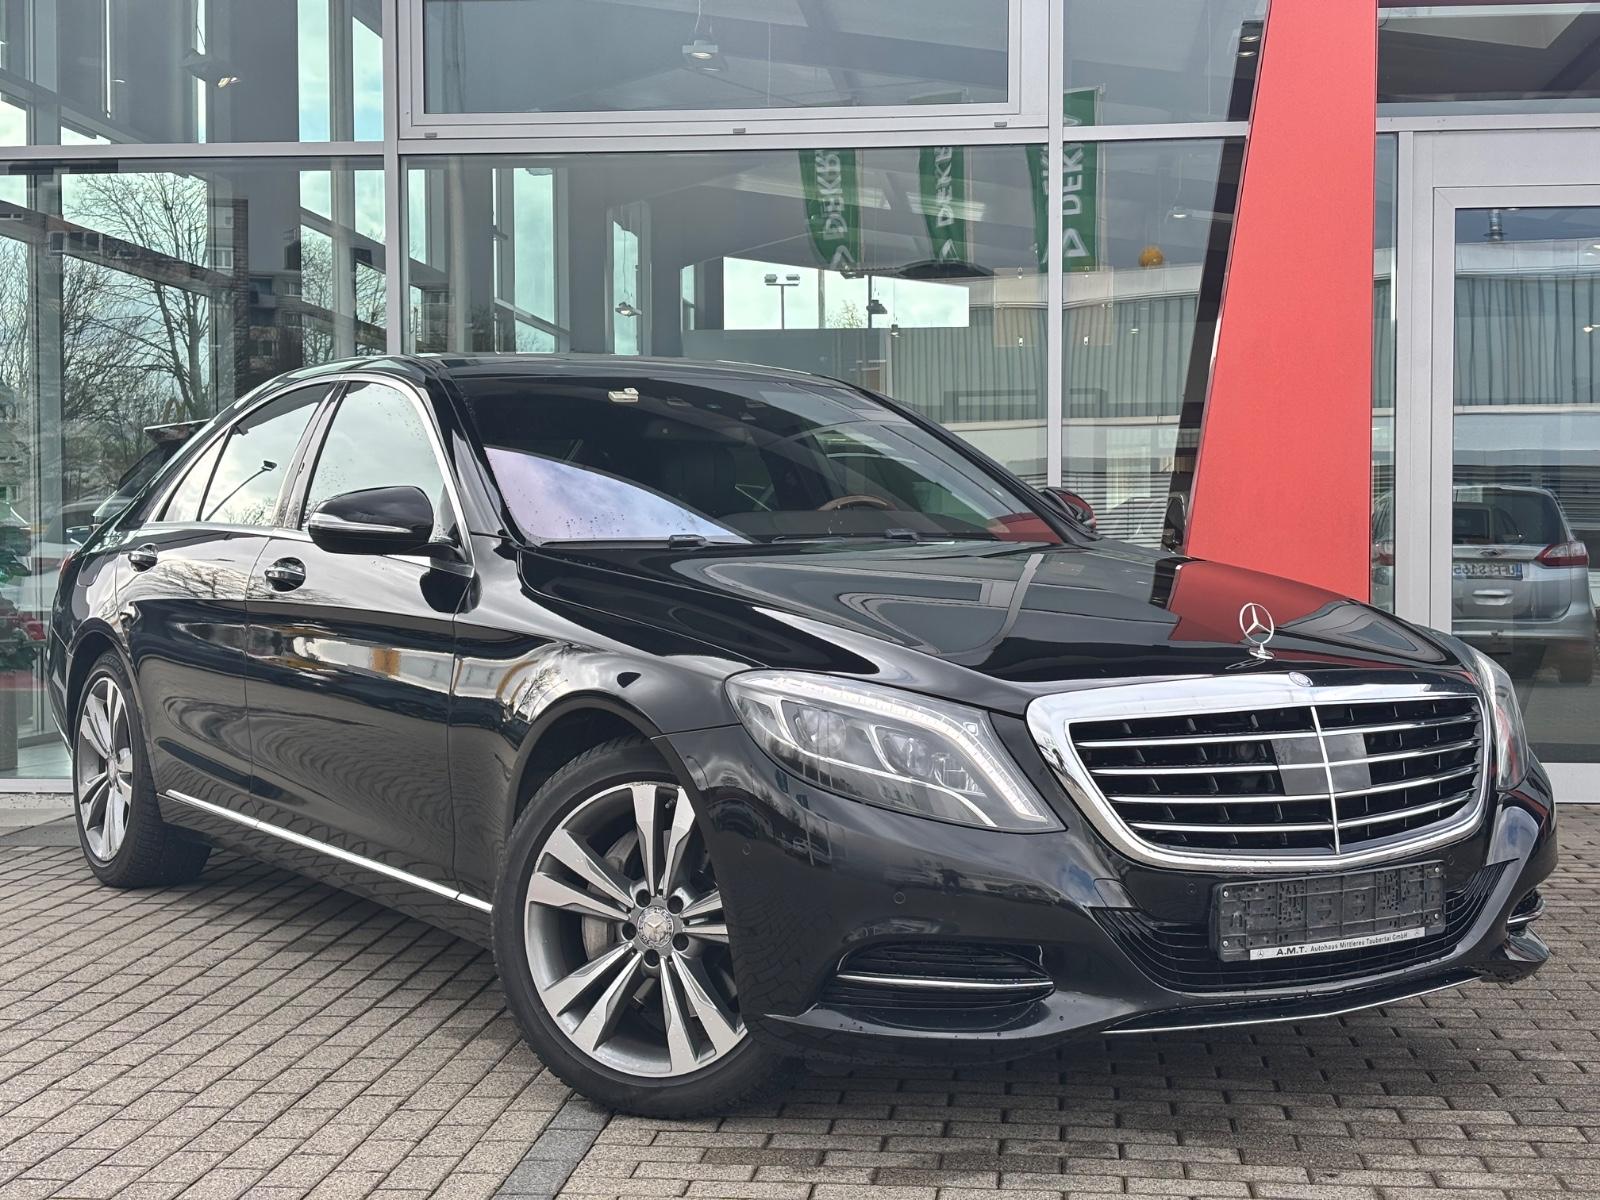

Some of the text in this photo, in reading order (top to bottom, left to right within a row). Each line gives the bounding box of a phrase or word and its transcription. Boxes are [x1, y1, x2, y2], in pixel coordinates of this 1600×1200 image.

[1276, 932, 1408, 956] A.M.T. Autohaus Mittleres Taubertal GmbH
